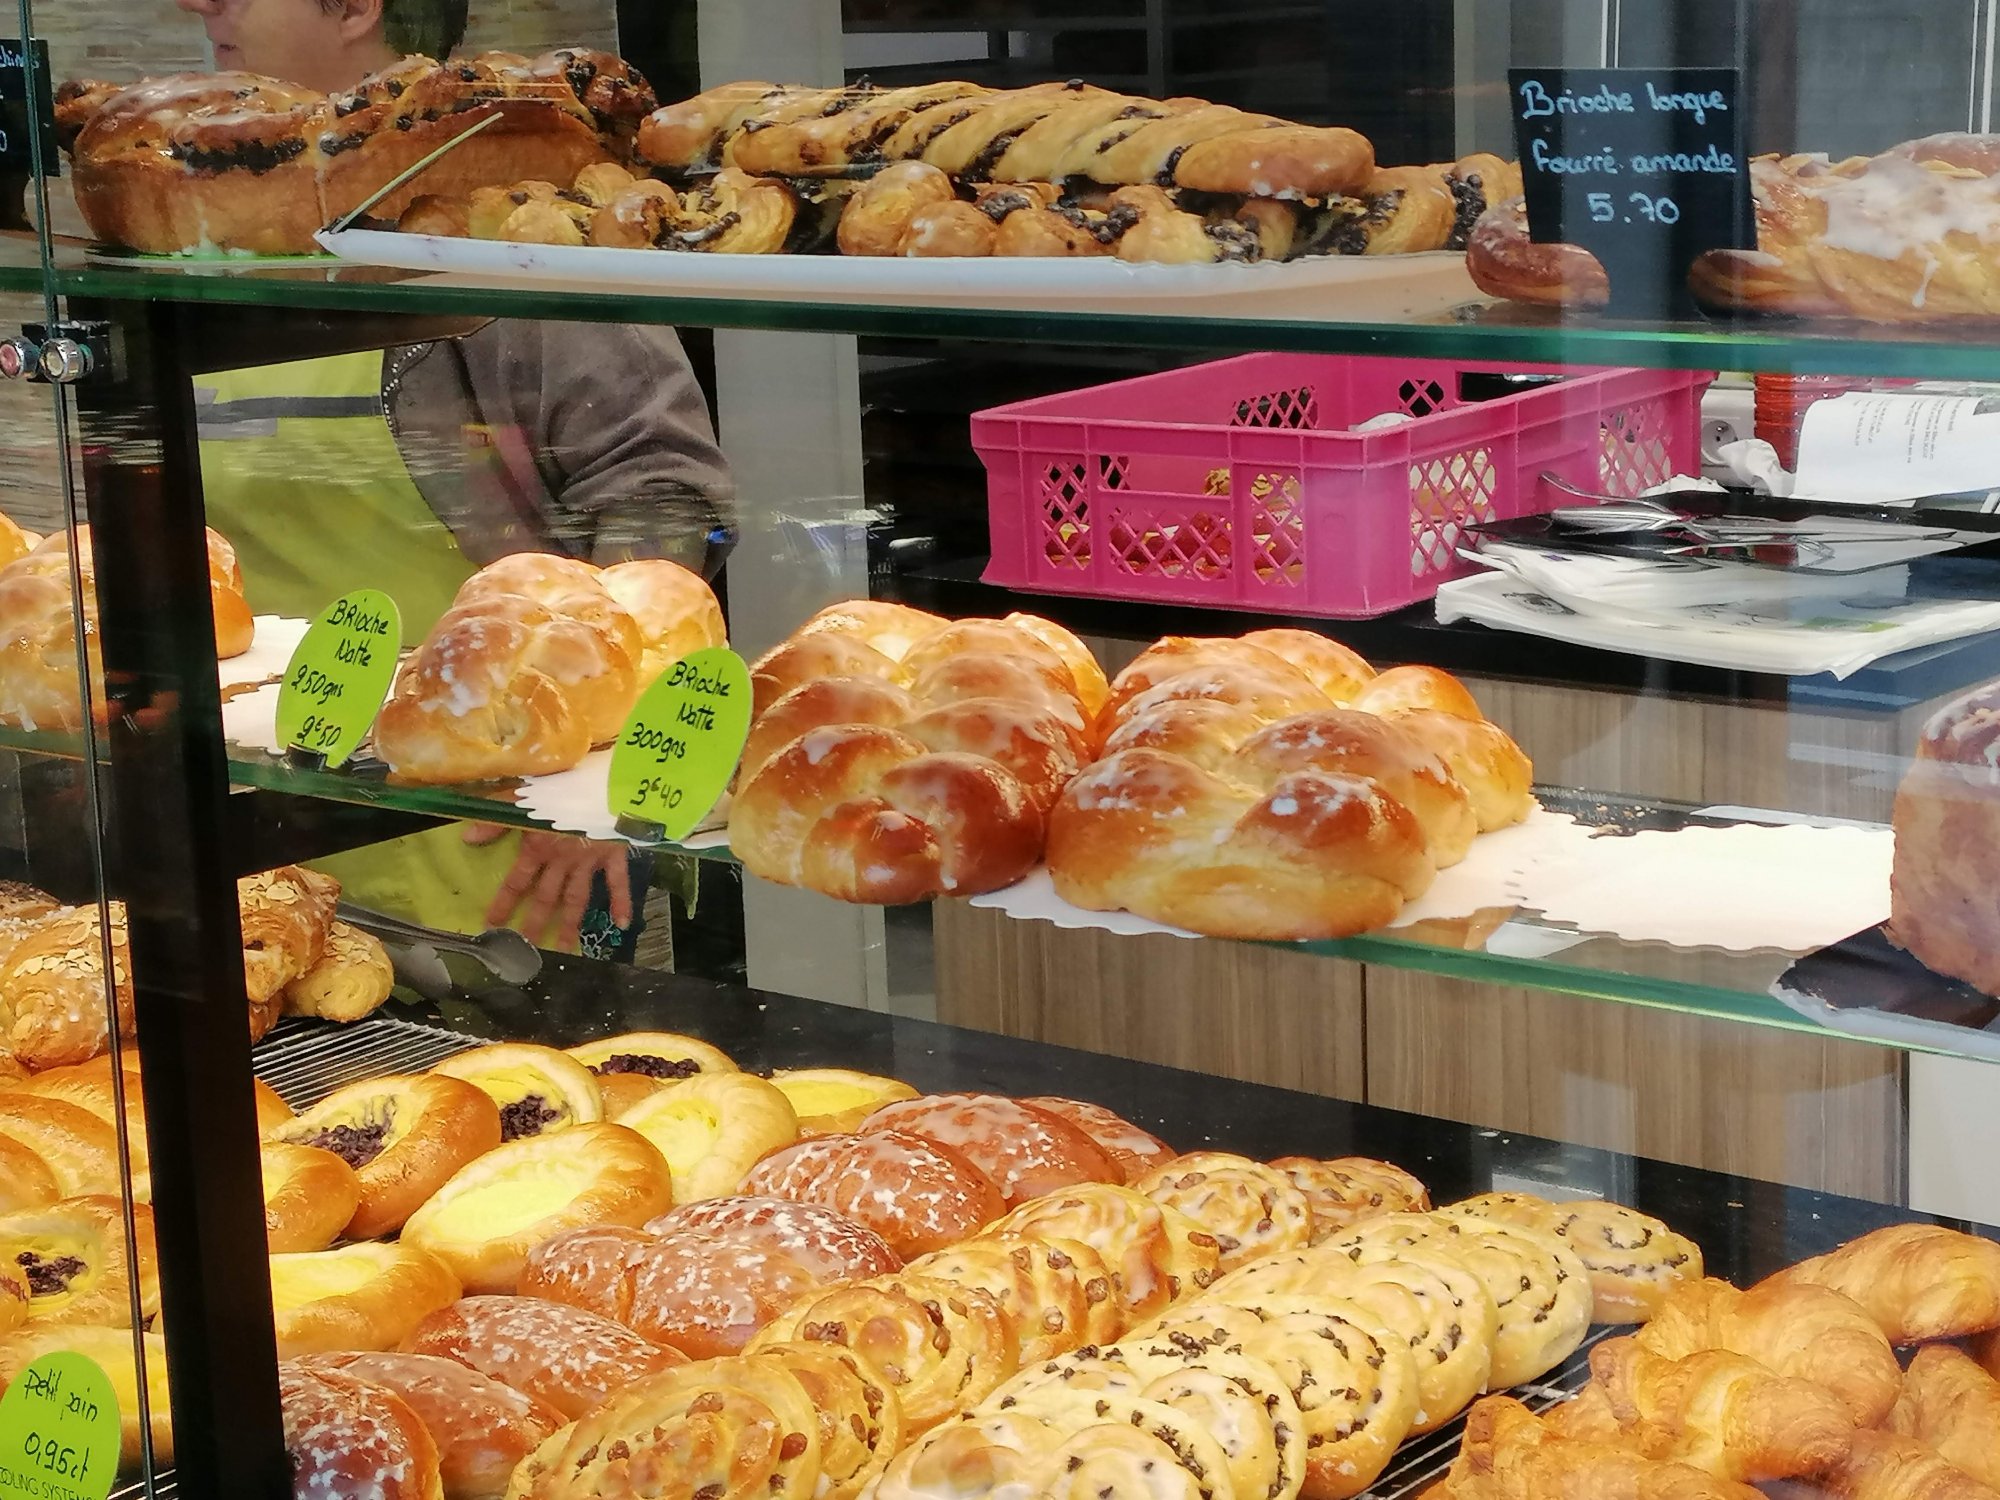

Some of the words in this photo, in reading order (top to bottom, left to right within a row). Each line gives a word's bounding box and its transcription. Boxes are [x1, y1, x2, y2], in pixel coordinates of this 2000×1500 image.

[1519, 80, 1635, 119] Brioche
[1646, 81, 1728, 125] longue
[1631, 143, 1737, 174] amande
[1587, 192, 1681, 224] 5.70
